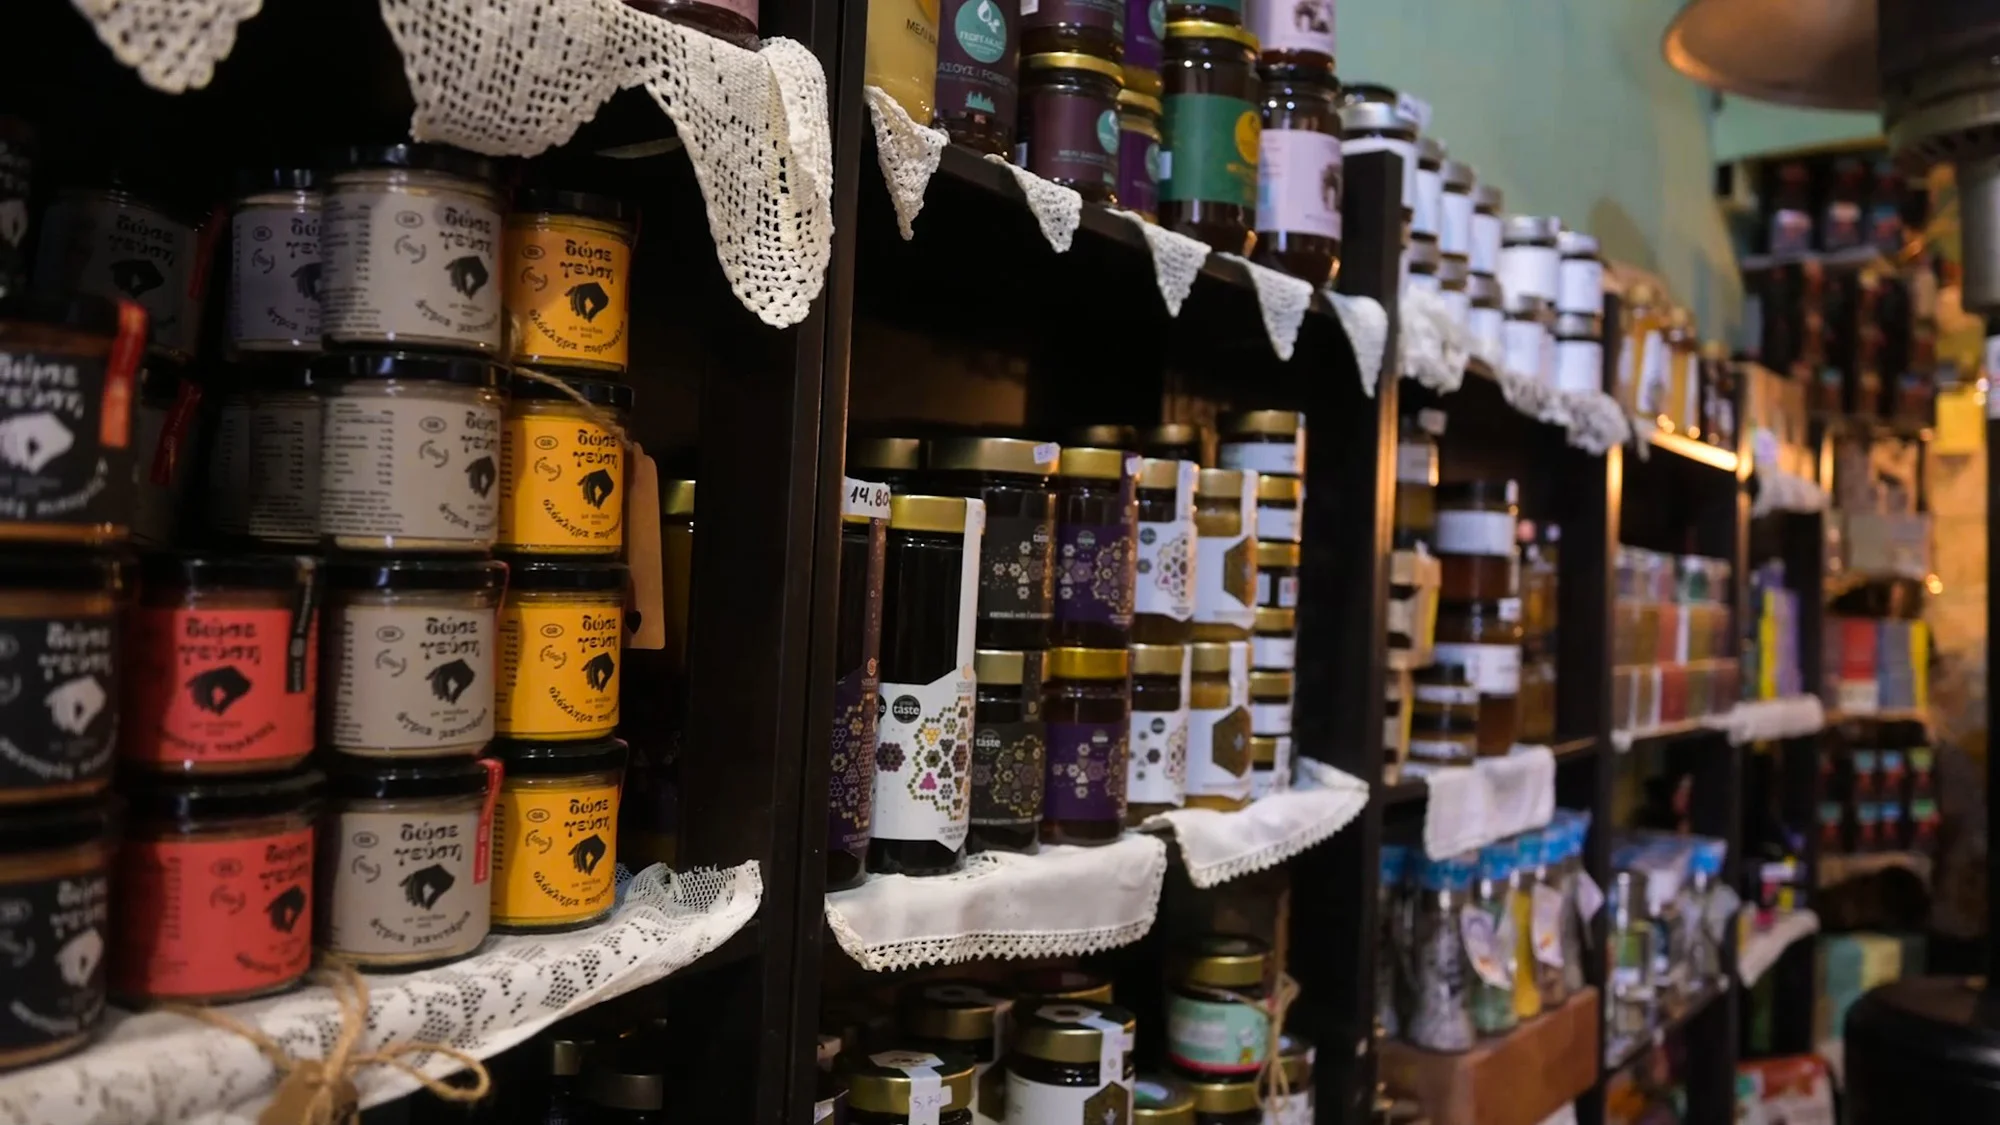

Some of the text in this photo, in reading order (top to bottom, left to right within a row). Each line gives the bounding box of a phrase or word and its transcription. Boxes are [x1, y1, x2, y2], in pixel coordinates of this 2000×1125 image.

[938, 62, 975, 76] ΑΣΟΥΣ
[445, 206, 491, 235] δώσε
[439, 229, 493, 260] γεύση
[565, 239, 612, 262] δώσε
[559, 260, 614, 285] γεύση
[578, 429, 617, 448] δώσε
[572, 447, 619, 470] γεύση
[425, 616, 478, 636] δώσε
[582, 613, 617, 632] δώσε
[419, 635, 481, 661] γεύση
[576, 632, 618, 653] γεύση
[892, 703, 921, 716] taste
[975, 737, 1001, 749] taste
[570, 797, 609, 815] δώσε
[400, 821, 459, 842] δώσε
[564, 815, 610, 838] γεύση
[393, 842, 463, 867] γεύση
